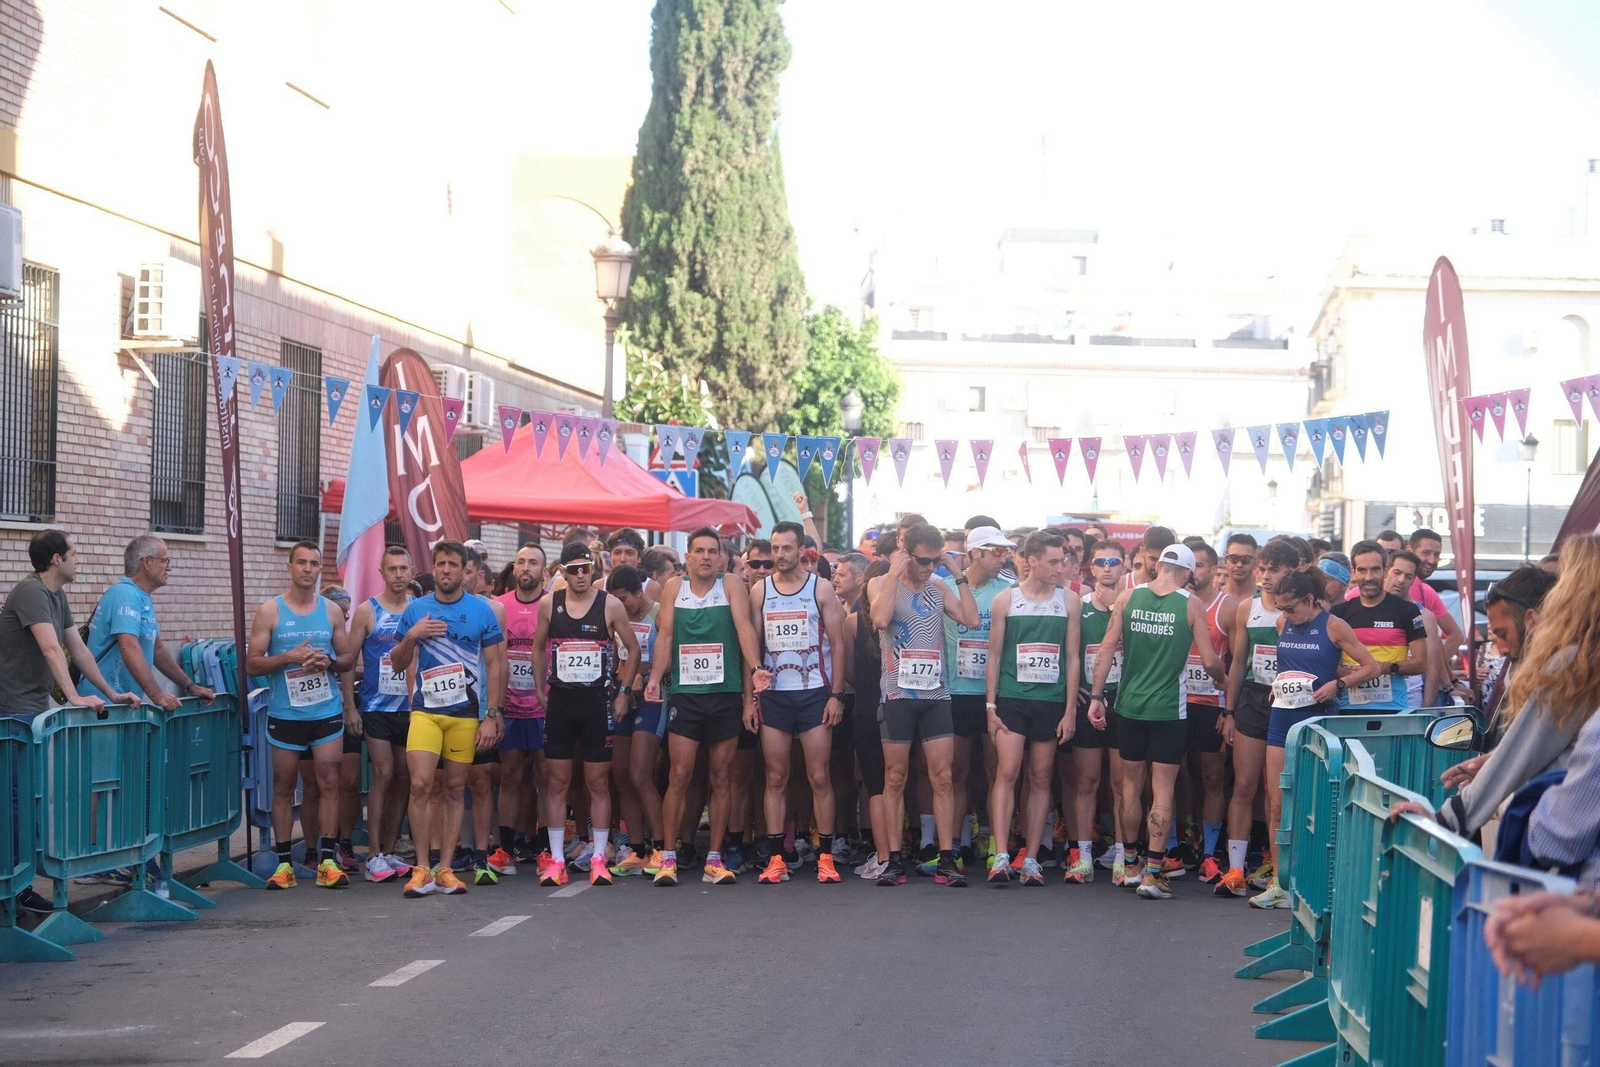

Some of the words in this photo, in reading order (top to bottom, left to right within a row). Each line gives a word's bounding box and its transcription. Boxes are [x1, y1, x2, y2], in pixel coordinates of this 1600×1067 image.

[1130, 609, 1176, 623] ATLETISMO
[776, 623, 798, 636] 189
[1130, 621, 1174, 636] CORDOBÉS
[1278, 641, 1320, 651] TROTASIERRA
[568, 655, 591, 667] 224
[693, 657, 709, 670] 80
[971, 652, 987, 665] 35
[1029, 656, 1051, 668] 278
[512, 664, 533, 677] 264
[911, 663, 934, 675] 177
[1264, 659, 1278, 671] 28
[390, 670, 406, 681] 20
[1188, 669, 1210, 681] 183
[298, 677, 322, 693] 283
[433, 678, 457, 693] 116
[1282, 682, 1303, 694] 663
